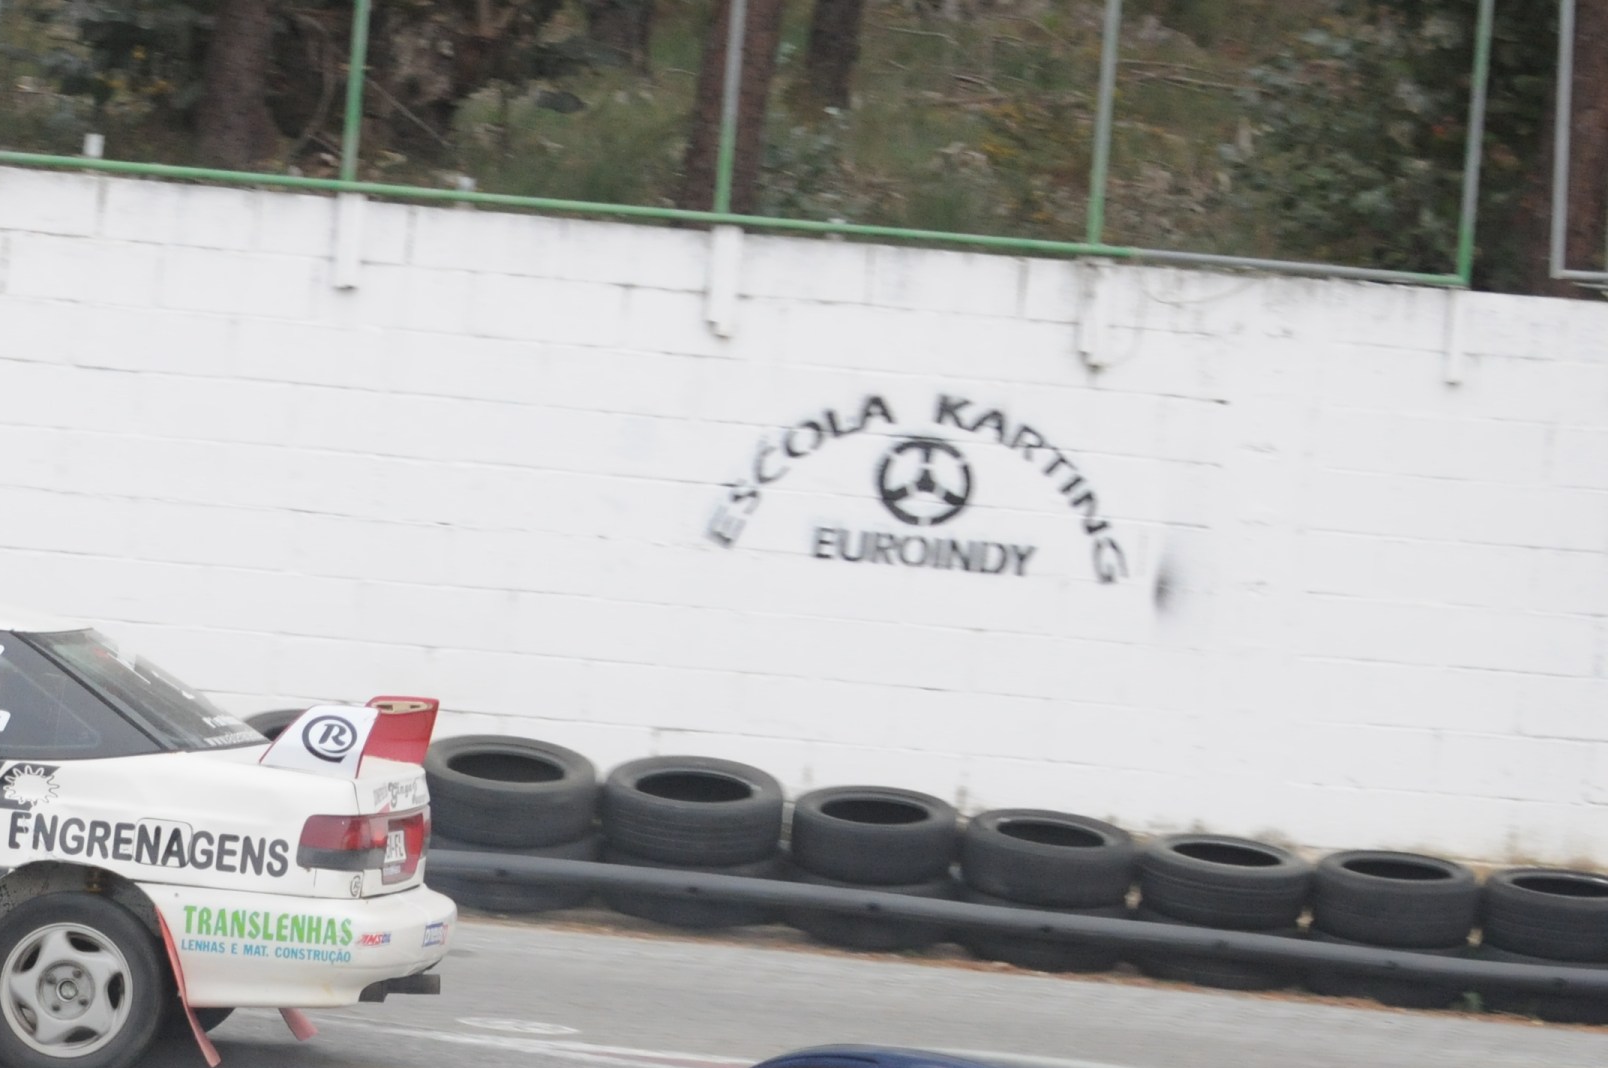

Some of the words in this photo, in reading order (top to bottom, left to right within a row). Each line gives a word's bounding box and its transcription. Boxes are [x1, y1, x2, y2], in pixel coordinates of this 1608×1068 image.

[704, 395, 896, 549] ESCOLA
[935, 395, 1129, 584] KARTING
[811, 526, 1038, 576] EUROINDY
[8, 810, 290, 878] ENGRENAGENS
[183, 905, 353, 946] TRANSLENHAS
[181, 939, 226, 954] LENHAS
[230, 943, 238, 955] E
[243, 945, 269, 957] MAT.
[274, 948, 352, 965] CONSTRUÇÃO
